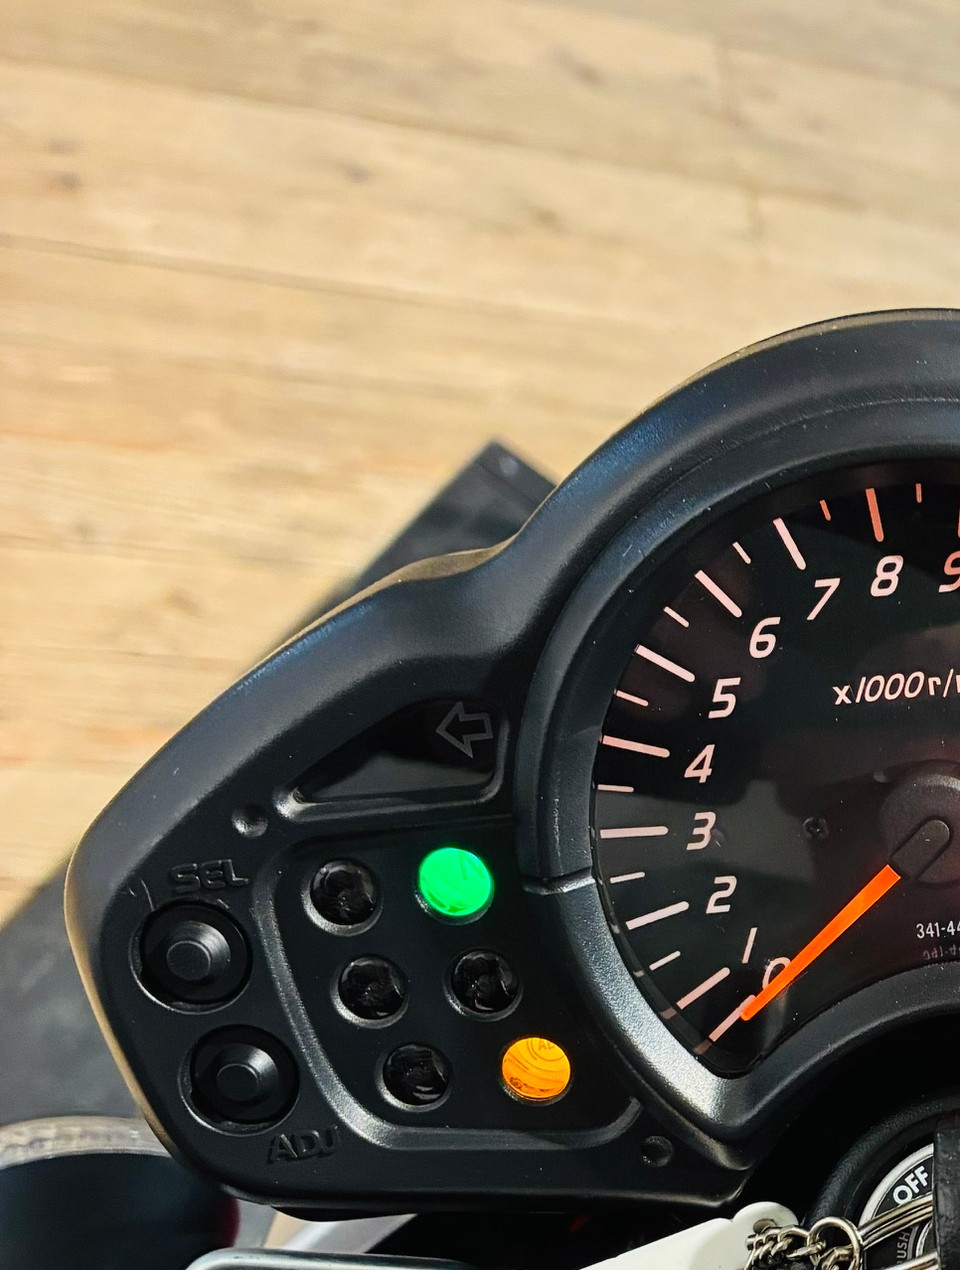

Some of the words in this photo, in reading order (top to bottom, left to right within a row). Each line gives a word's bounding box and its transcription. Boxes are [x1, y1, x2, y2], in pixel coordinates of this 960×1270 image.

[870, 555, 904, 597] 8
[806, 577, 841, 621] 7
[749, 616, 781, 659] 6
[708, 677, 741, 719] 5
[684, 744, 716, 784] 4
[686, 811, 717, 851] 3
[168, 857, 250, 895] SEL
[705, 875, 737, 914] 2
[741, 927, 758, 964] 1
[892, 1165, 929, 1205] OFF
